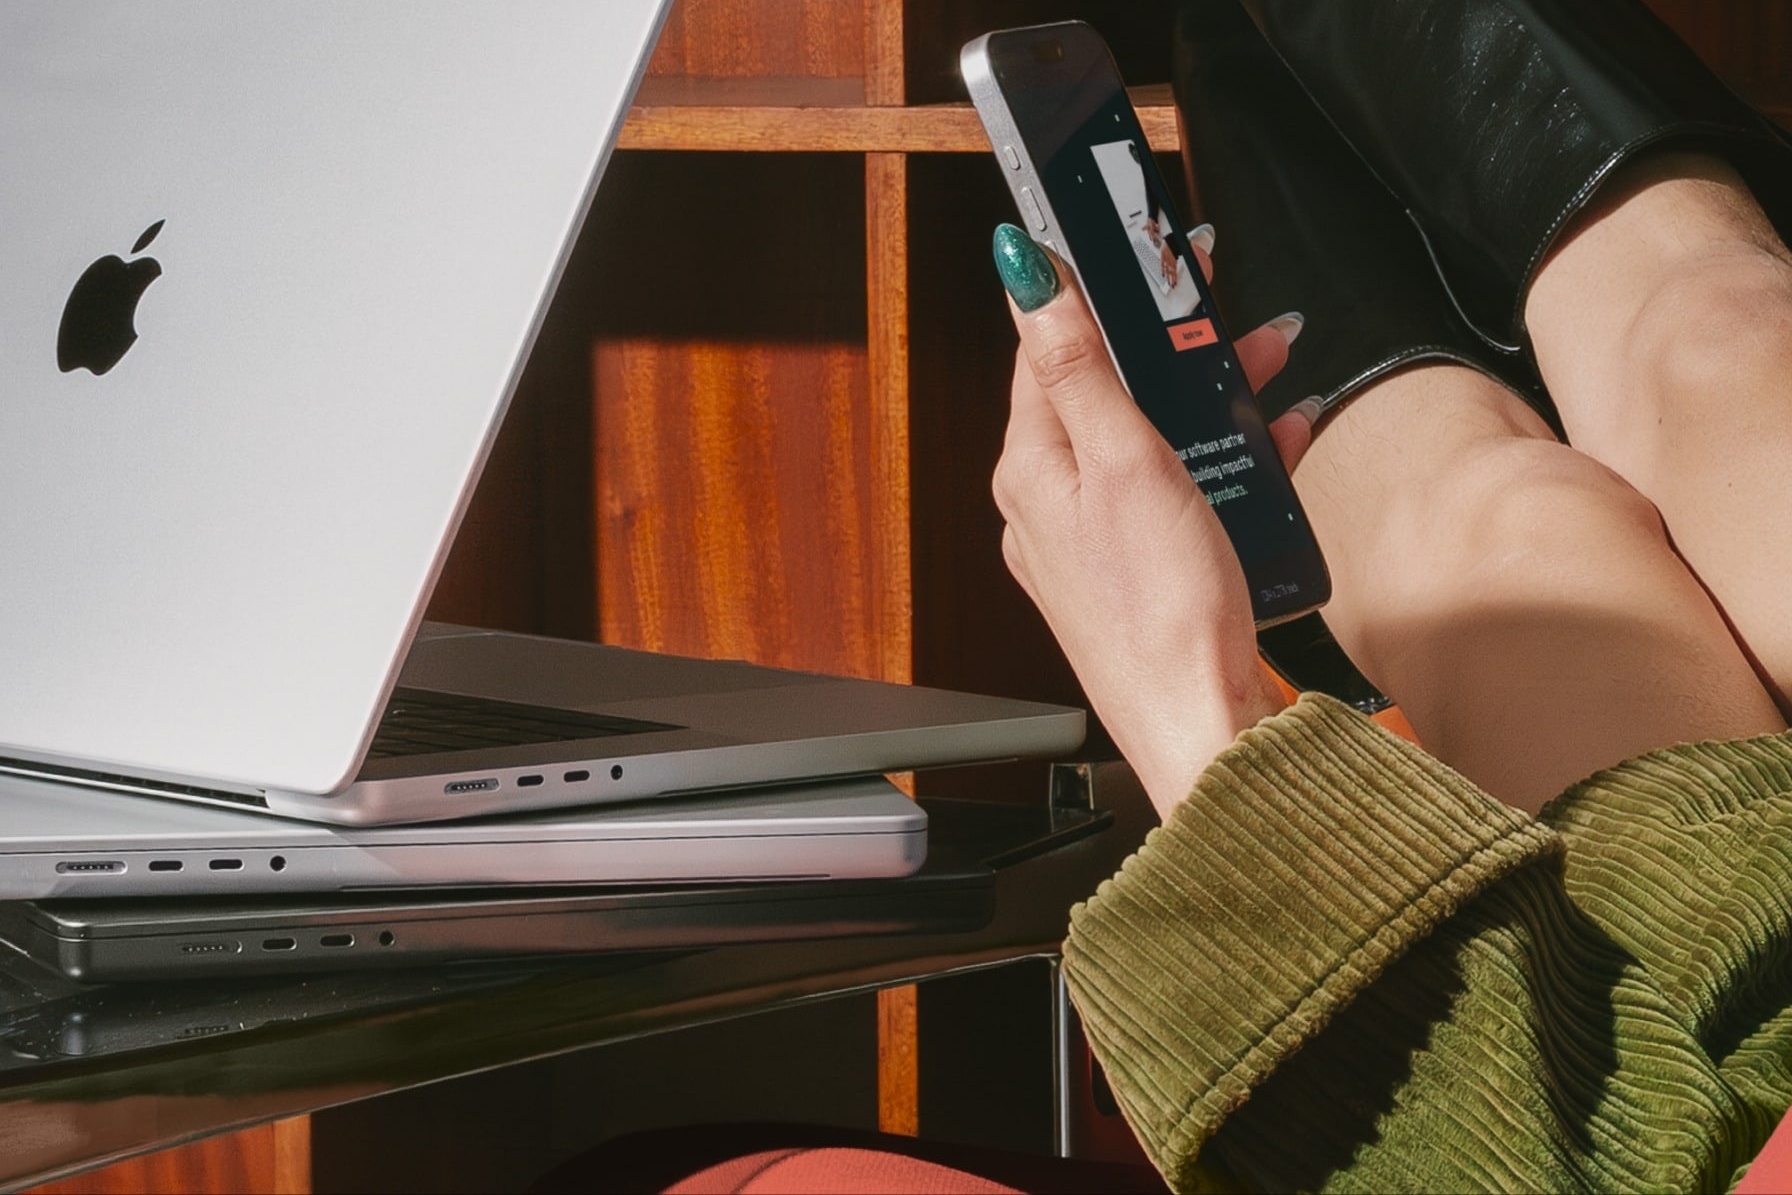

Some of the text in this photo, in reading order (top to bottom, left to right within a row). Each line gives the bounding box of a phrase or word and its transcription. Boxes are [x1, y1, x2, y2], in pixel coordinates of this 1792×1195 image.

[1187, 440, 1221, 459] software
[1219, 432, 1246, 453] partner
[1219, 453, 1256, 476] impactful
[1213, 483, 1249, 507] products.
